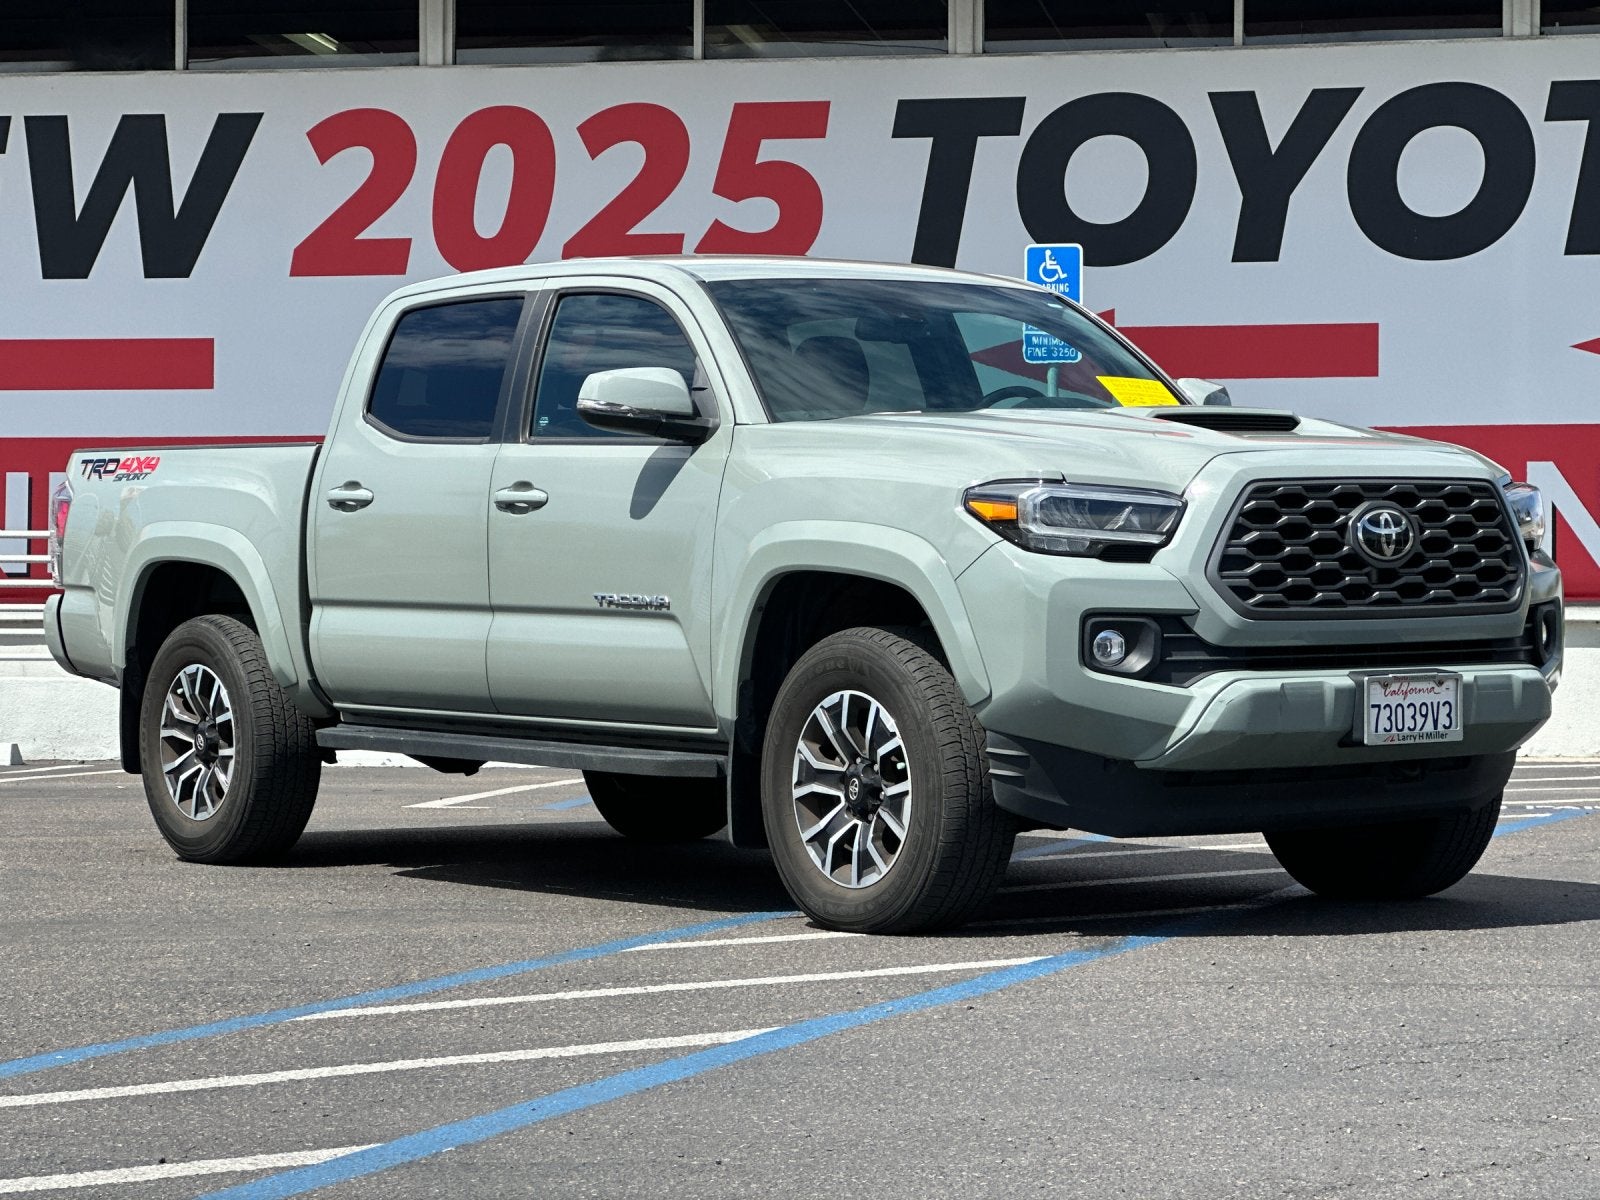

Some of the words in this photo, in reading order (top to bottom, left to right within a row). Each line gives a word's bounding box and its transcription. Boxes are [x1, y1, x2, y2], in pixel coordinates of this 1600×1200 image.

[0, 112, 264, 279] W
[289, 101, 830, 277] 2025
[1027, 347, 1047, 357] FINE
[81, 458, 120, 480] TRD
[113, 472, 152, 482] SPORT
[593, 592, 669, 608] TACOMA
[1383, 682, 1440, 700] California
[1371, 700, 1453, 733] 73039V3
[1397, 732, 1417, 743] Larry
[1418, 732, 1425, 741] H
[1425, 730, 1449, 741] Miller
